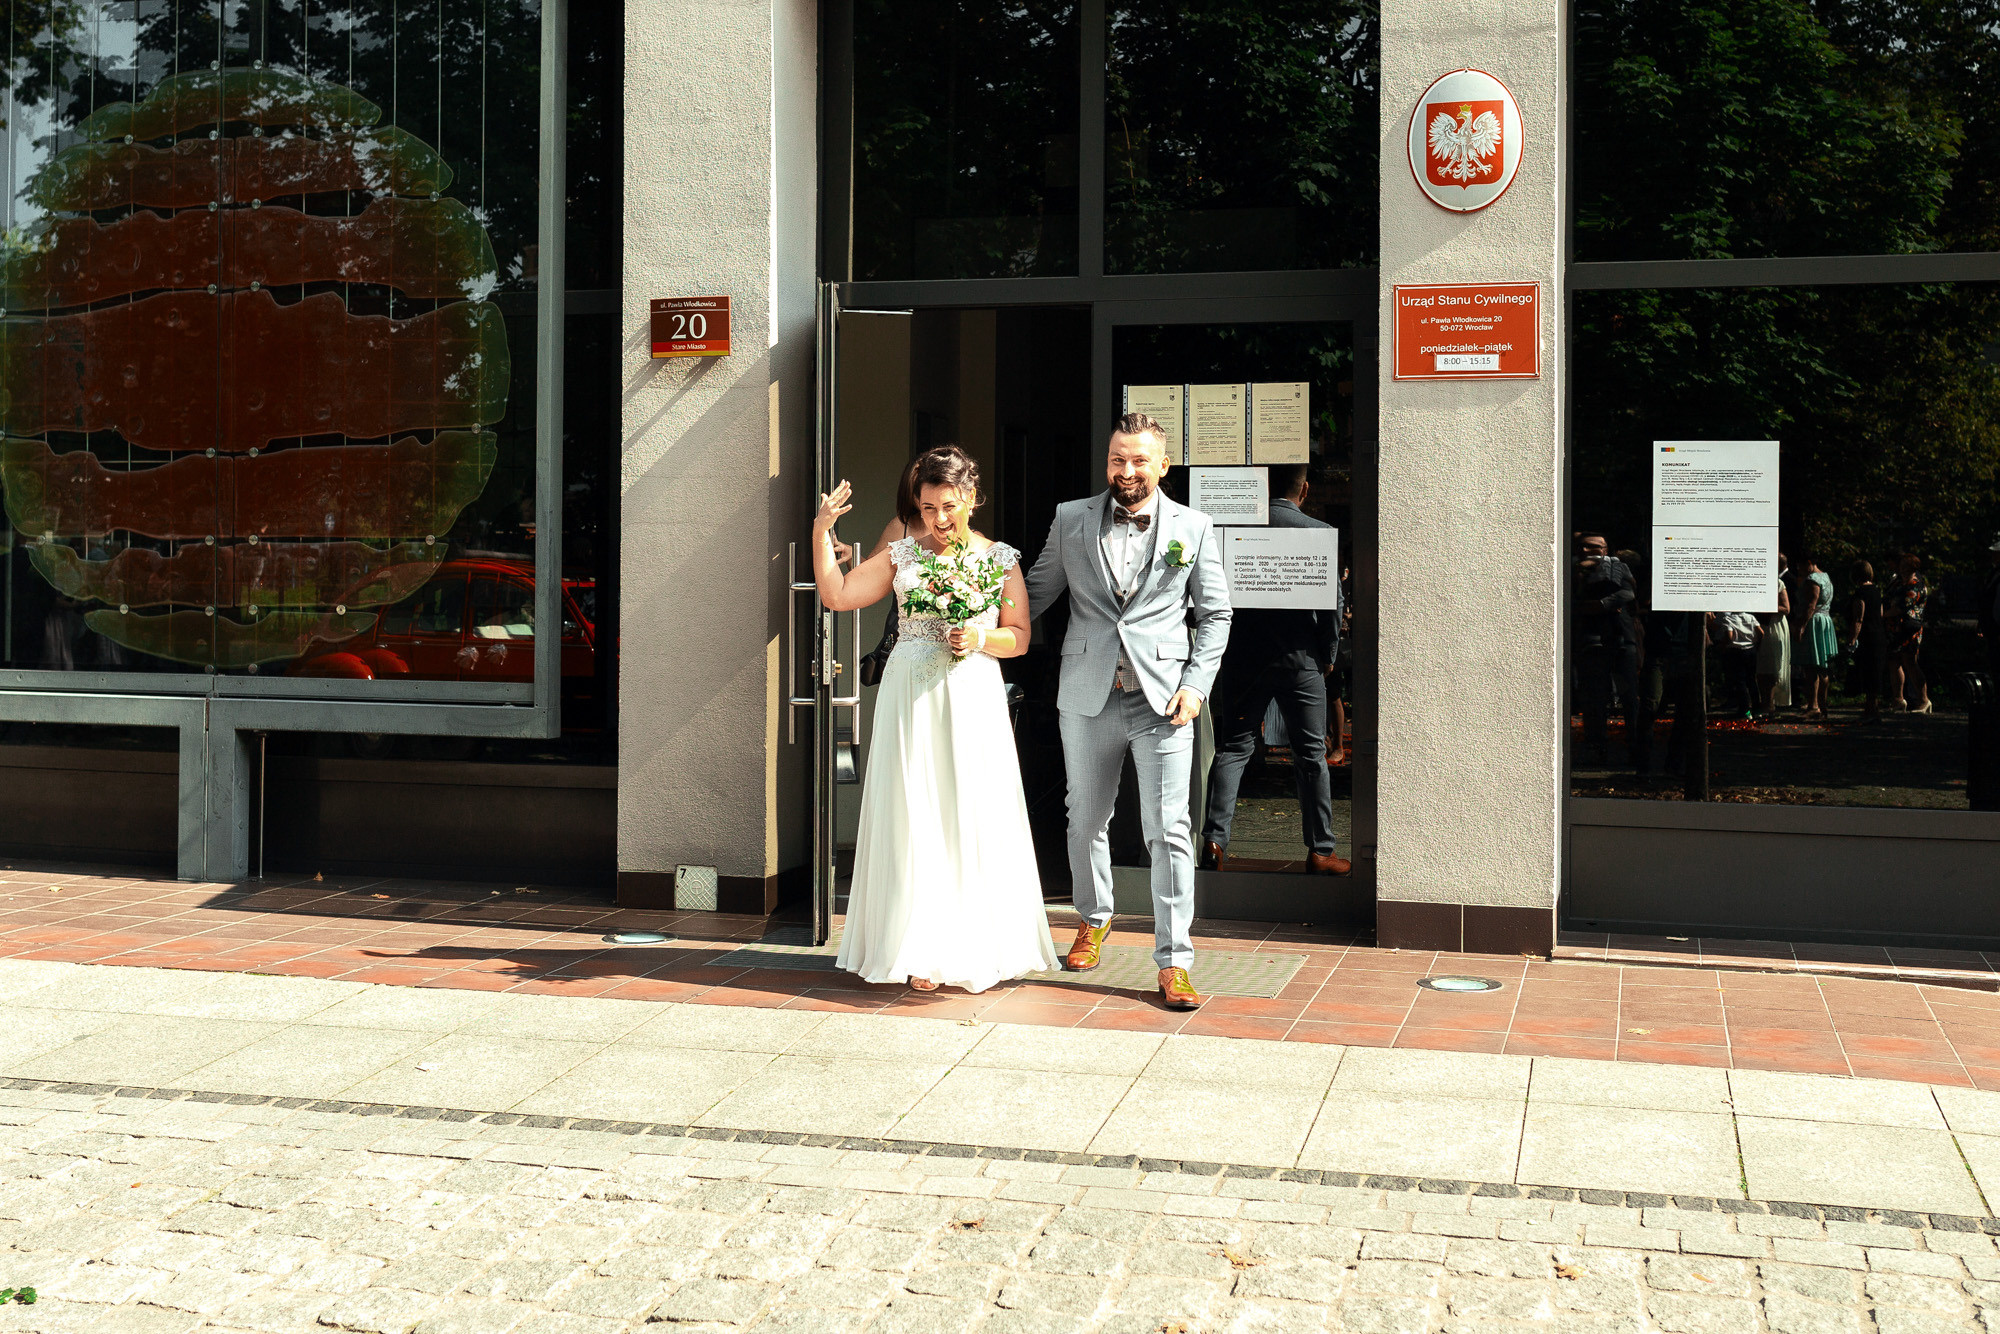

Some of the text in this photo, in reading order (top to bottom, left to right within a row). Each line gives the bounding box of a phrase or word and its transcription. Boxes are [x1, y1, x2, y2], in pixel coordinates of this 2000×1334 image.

[1401, 293, 1533, 308] Urząd Stanu Cywilnego
[671, 313, 707, 339] 20
[1443, 357, 1461, 365] 8:00
[1470, 357, 1491, 365] 15:15
[680, 868, 687, 879] 7
